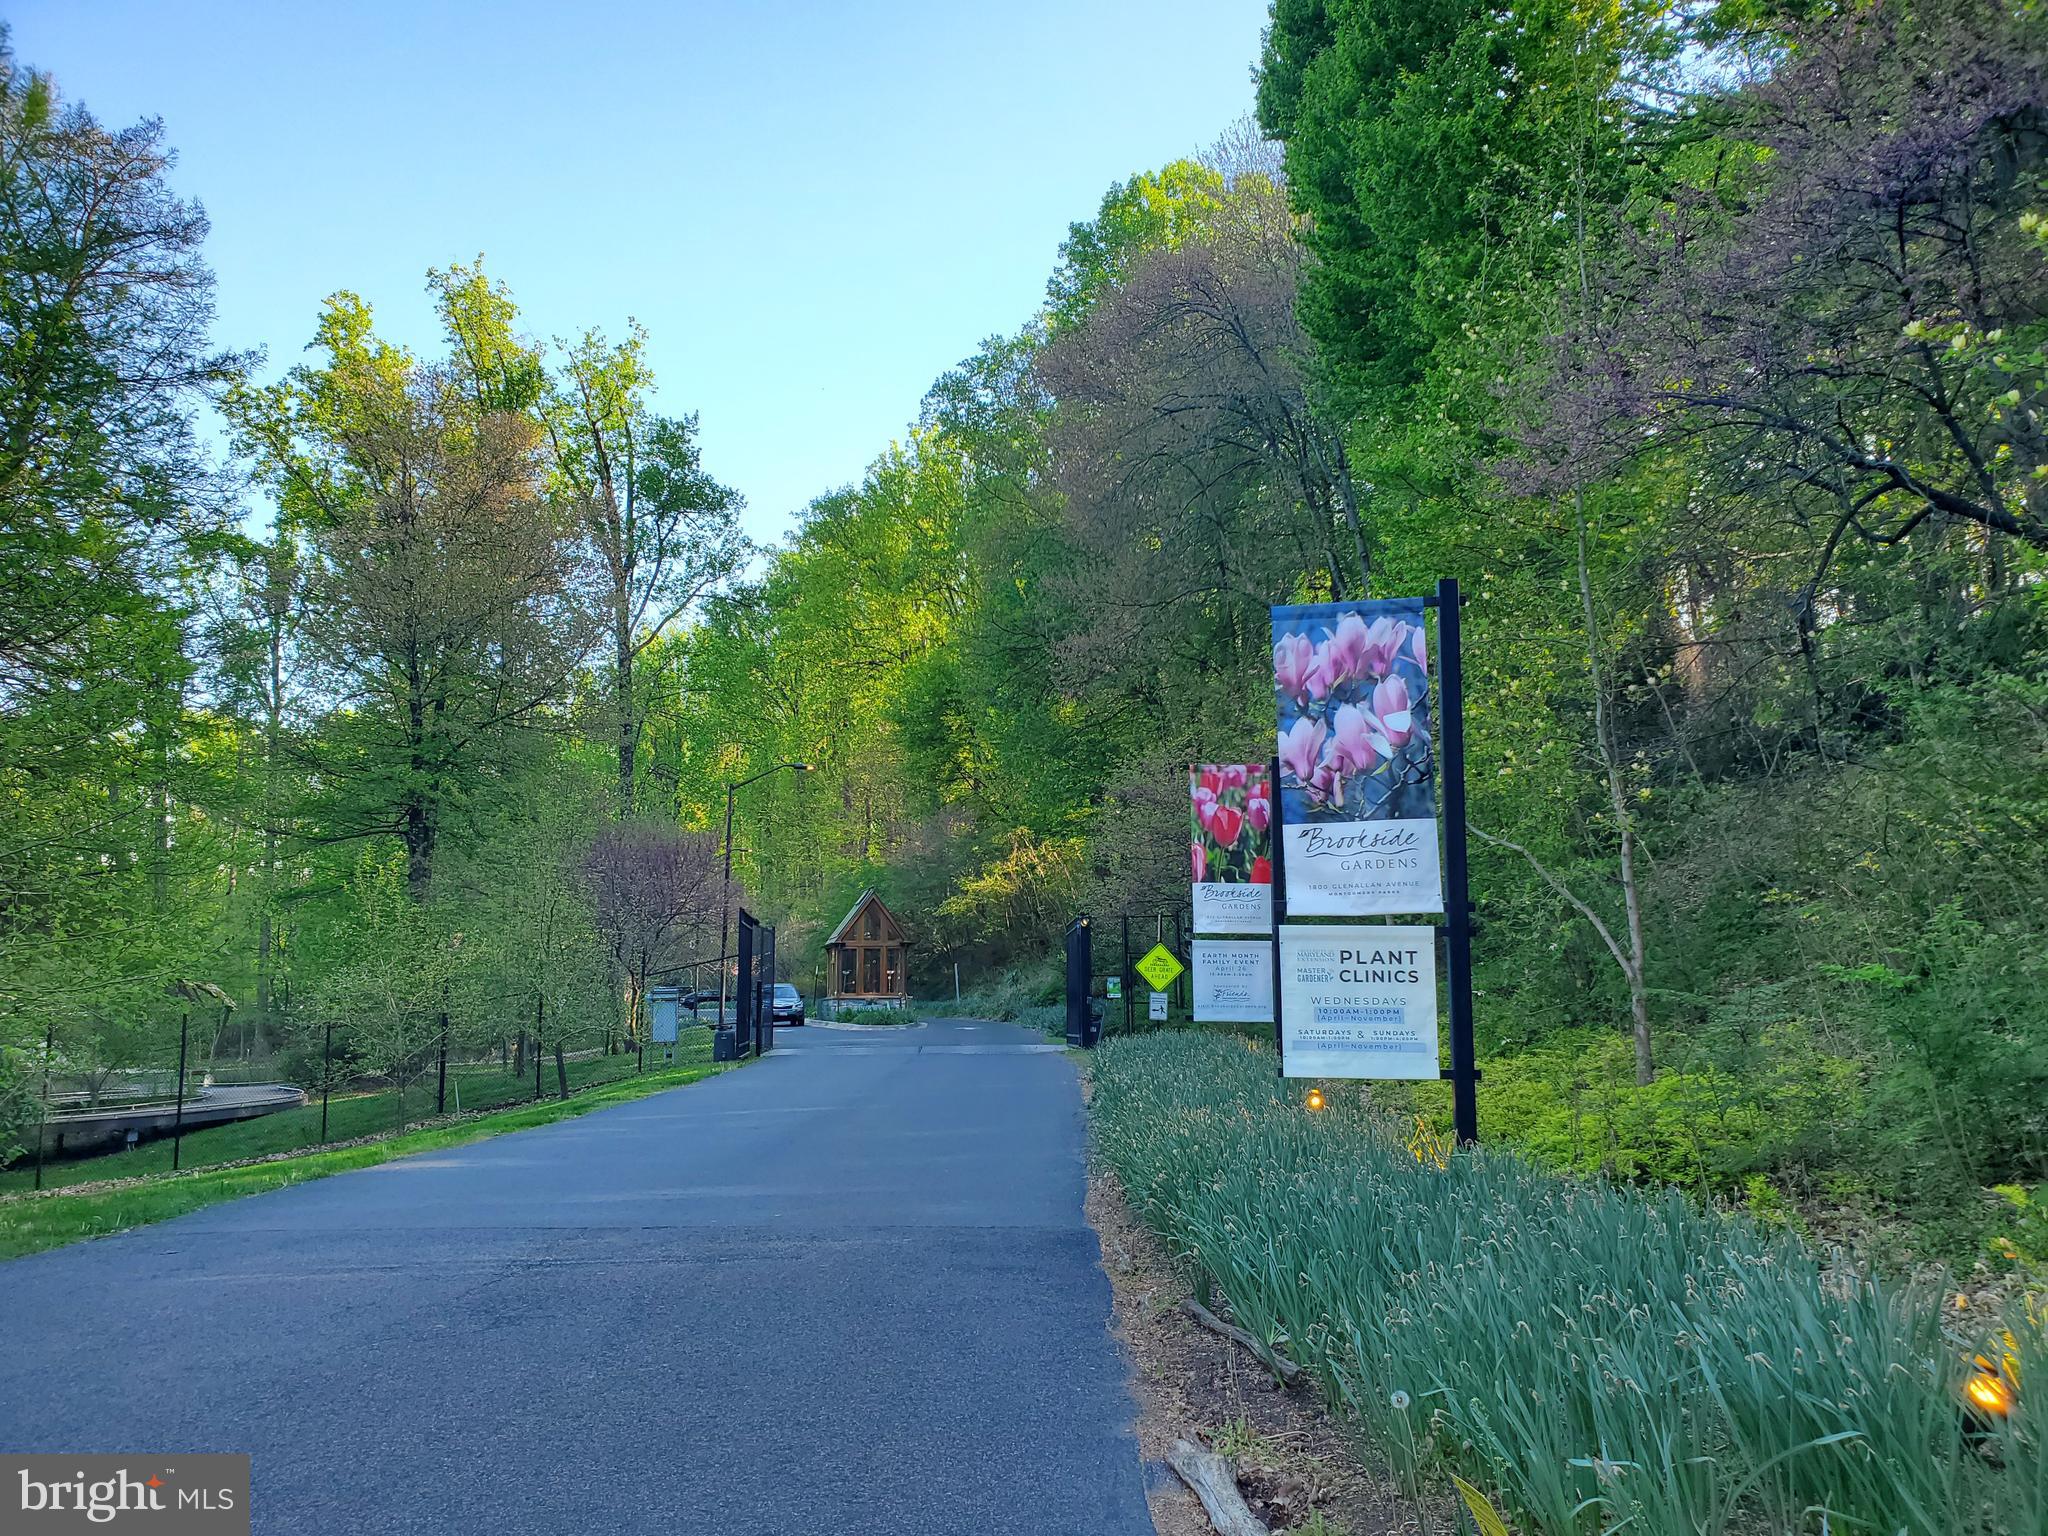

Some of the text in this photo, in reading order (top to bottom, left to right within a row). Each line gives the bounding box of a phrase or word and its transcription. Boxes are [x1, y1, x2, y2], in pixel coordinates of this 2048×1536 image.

[1303, 827, 1419, 852] Brookside
[1340, 857, 1418, 871] GARDENS
[1331, 882, 1382, 890] GLENALLAN
[1385, 880, 1420, 888] AVENUE
[1204, 884, 1262, 899] Brookside
[1221, 903, 1262, 911] GARDENS
[1339, 950, 1418, 965] PLANT
[1296, 974, 1329, 983] GARDENER
[1339, 969, 1419, 984] CLINICS
[1310, 996, 1407, 1006] WEDNESDAYS
[1356, 1030, 1365, 1039] &
